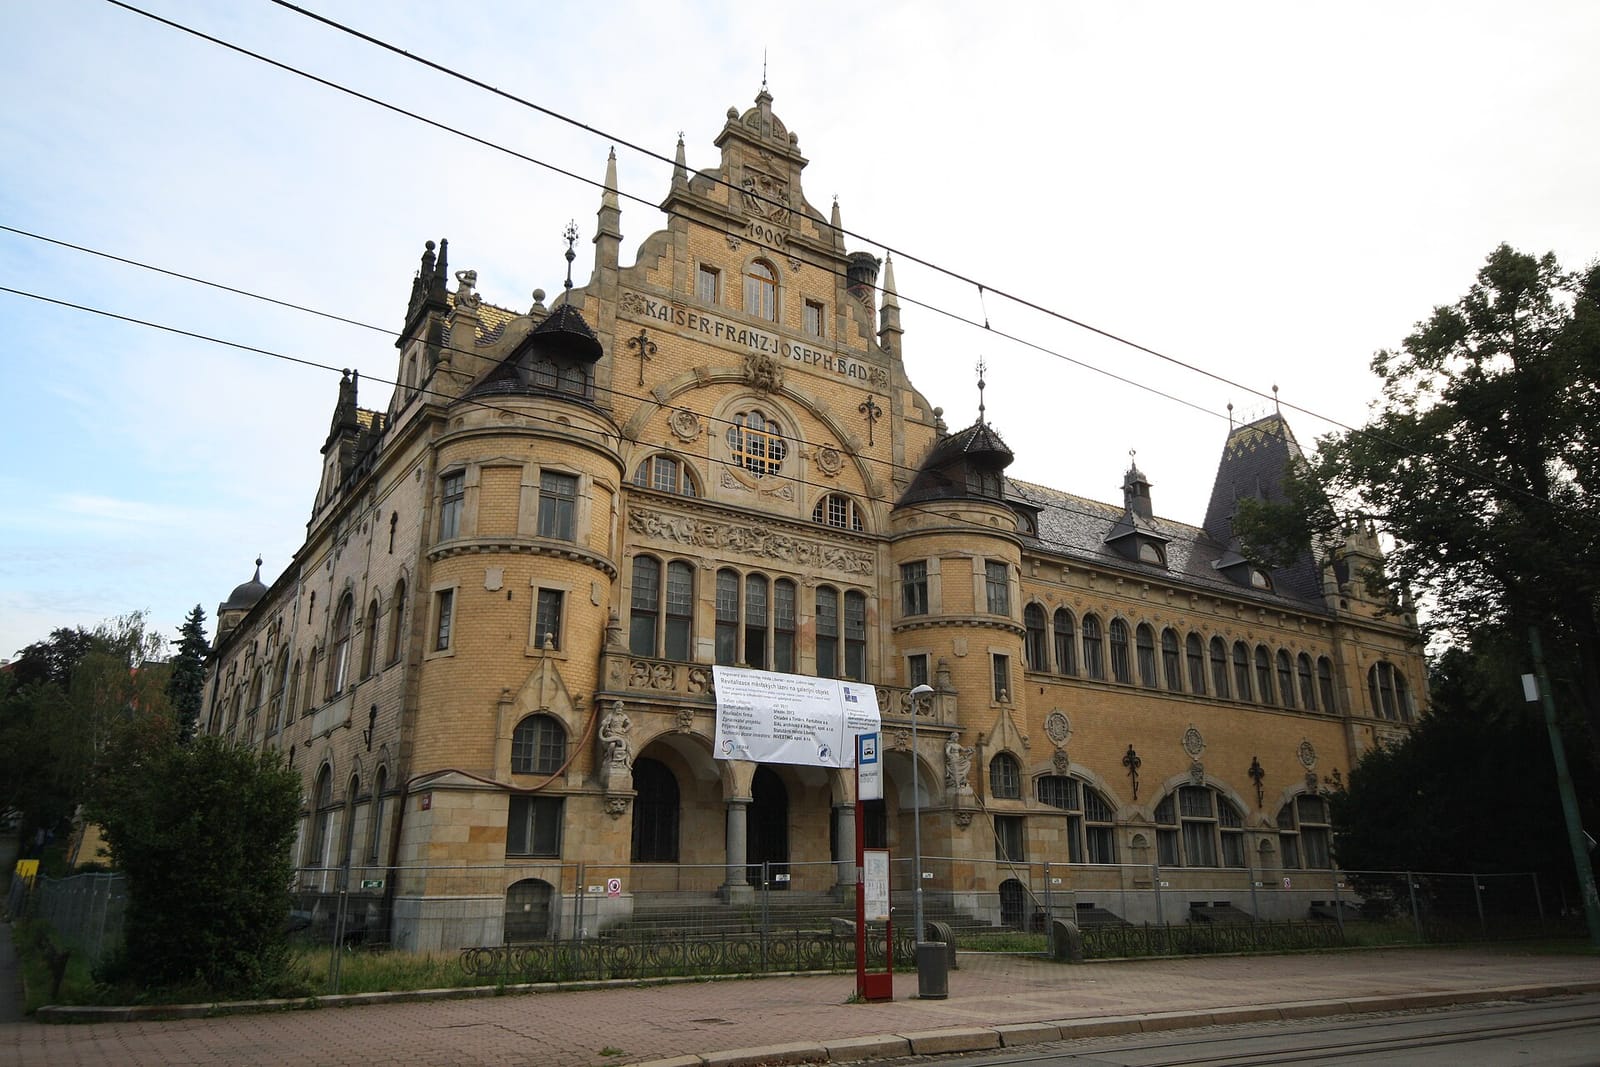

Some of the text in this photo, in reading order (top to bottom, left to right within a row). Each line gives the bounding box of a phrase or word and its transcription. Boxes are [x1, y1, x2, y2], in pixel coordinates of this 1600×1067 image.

[645, 299, 867, 380] KAISER FRANZ JOSEPH BAD
